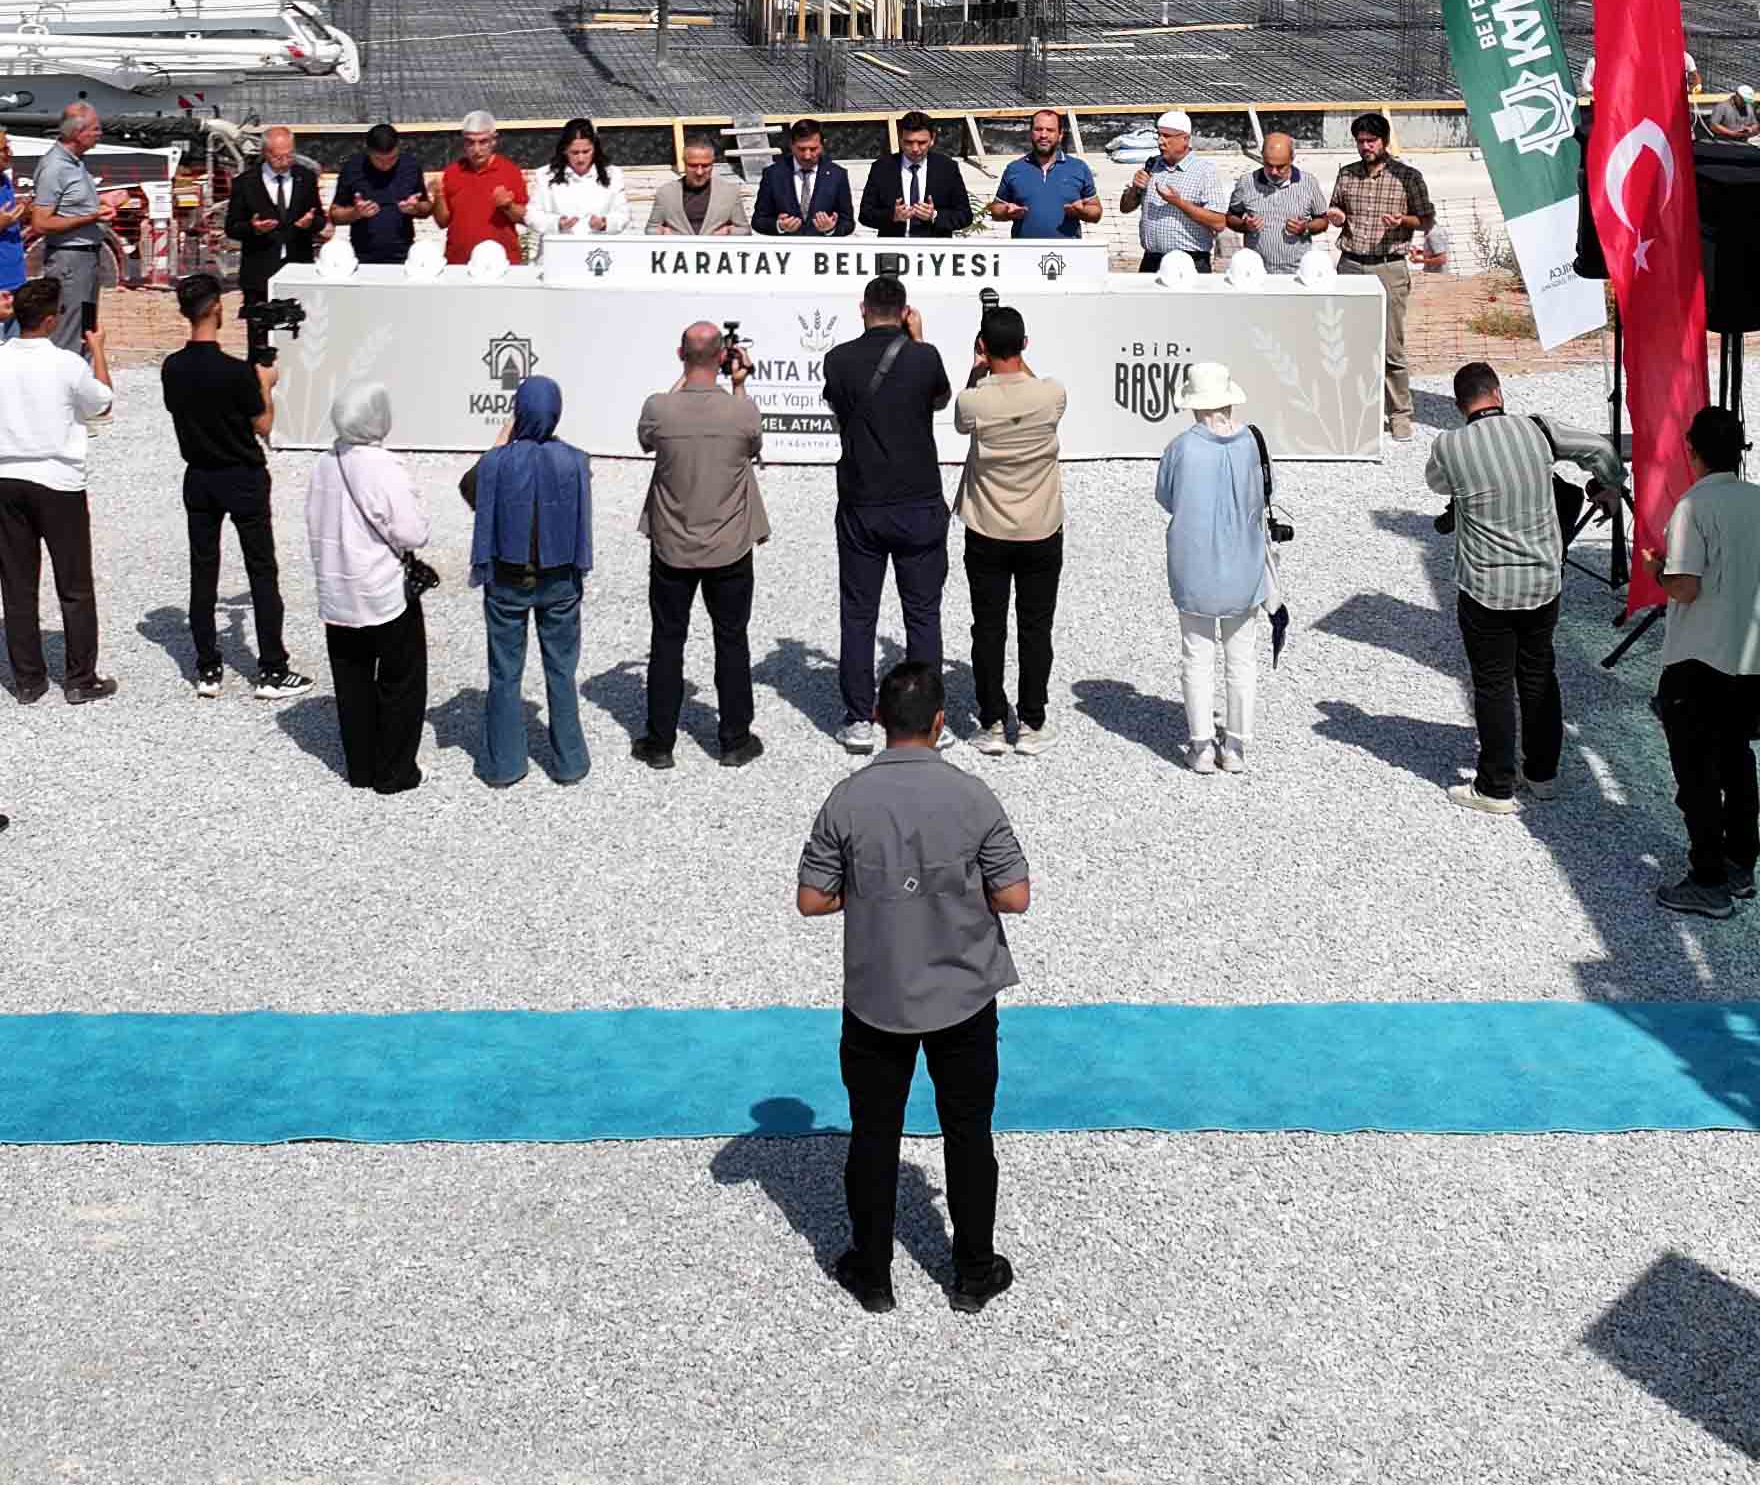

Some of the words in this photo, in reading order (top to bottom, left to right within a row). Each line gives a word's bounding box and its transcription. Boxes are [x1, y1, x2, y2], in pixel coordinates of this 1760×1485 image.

[651, 251, 792, 275] KARATAY
[753, 393, 777, 407] nut
[783, 394, 814, 411] Yapı
[761, 419, 786, 431] MEL
[791, 419, 833, 431] ATMA
